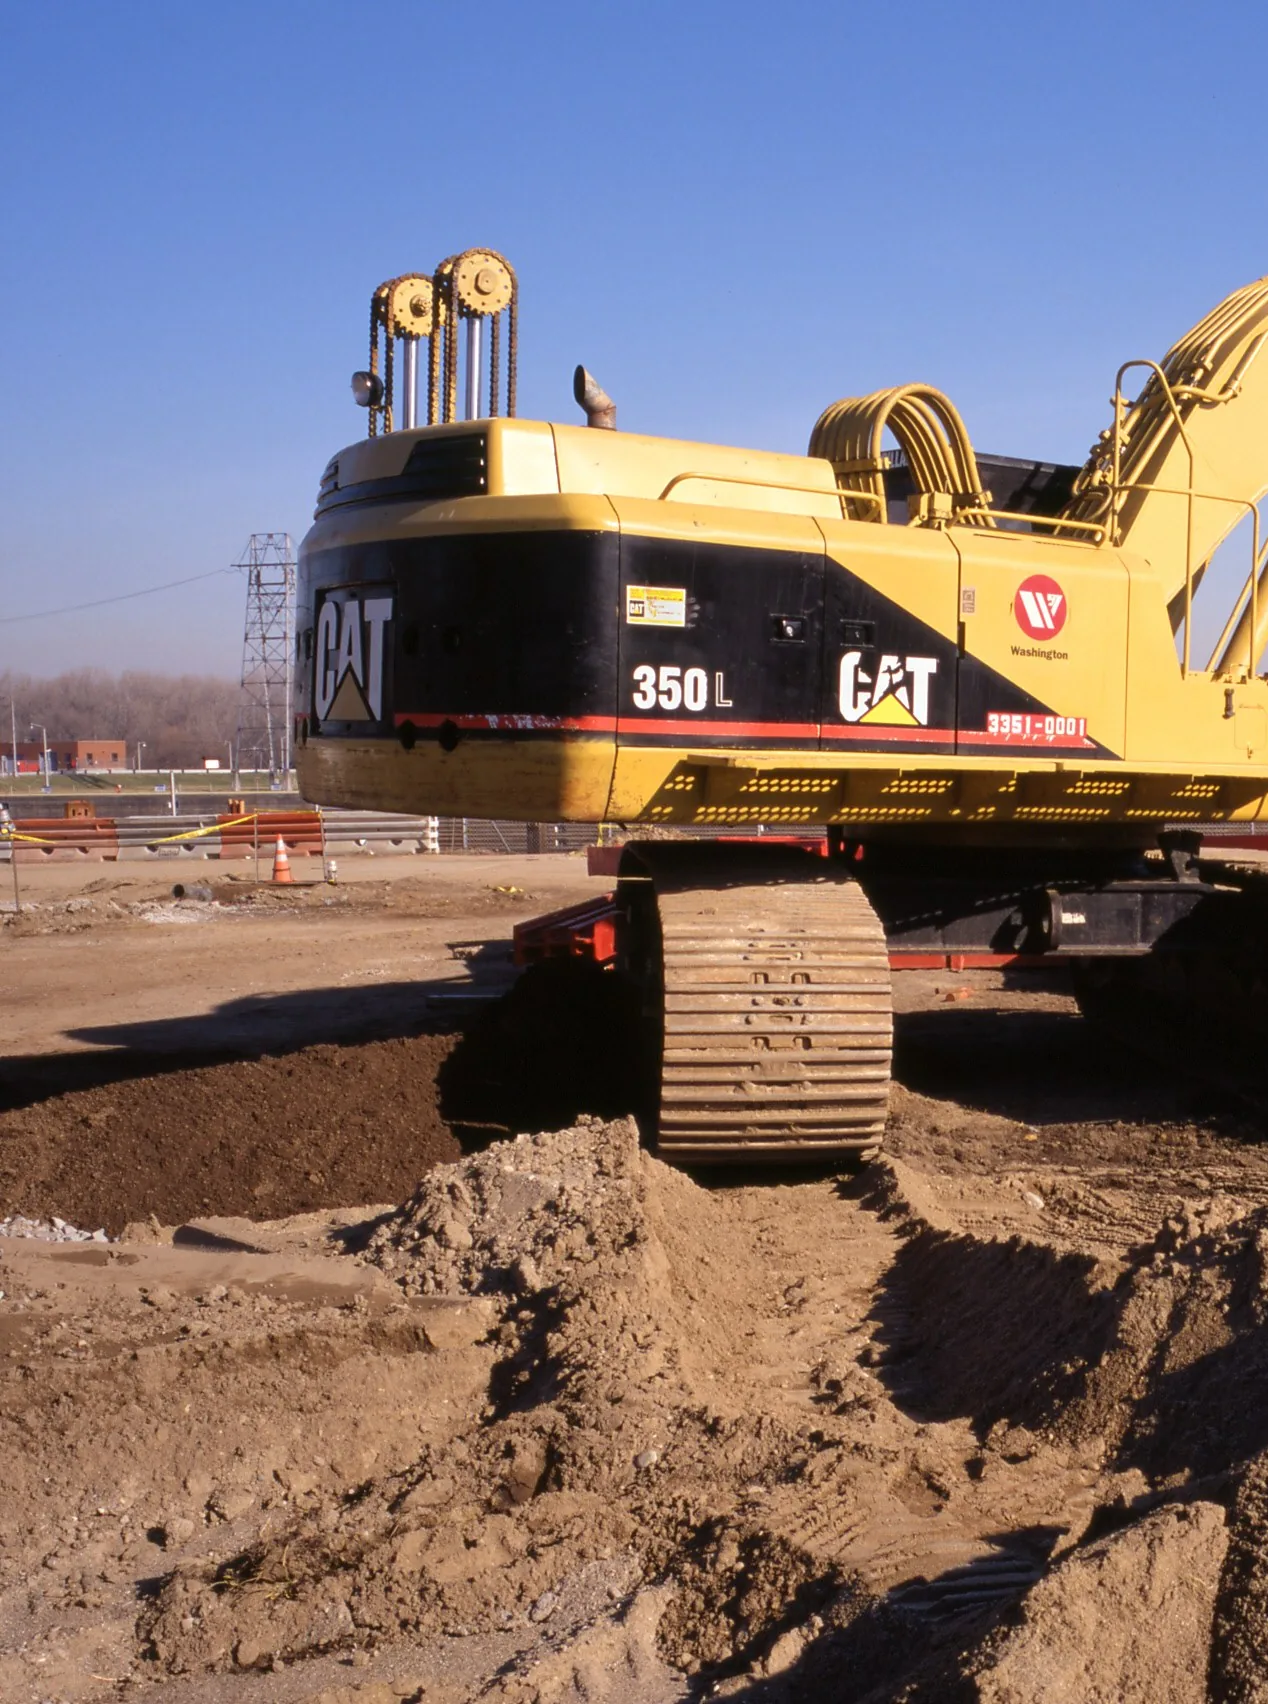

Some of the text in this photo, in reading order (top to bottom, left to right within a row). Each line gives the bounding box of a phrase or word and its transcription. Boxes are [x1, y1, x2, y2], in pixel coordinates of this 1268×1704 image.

[315, 598, 393, 721] CAT
[1011, 645, 1068, 660] Washington
[633, 665, 733, 711] 350 L
[839, 651, 937, 725] CAT
[988, 713, 1085, 736] 3351-0001
